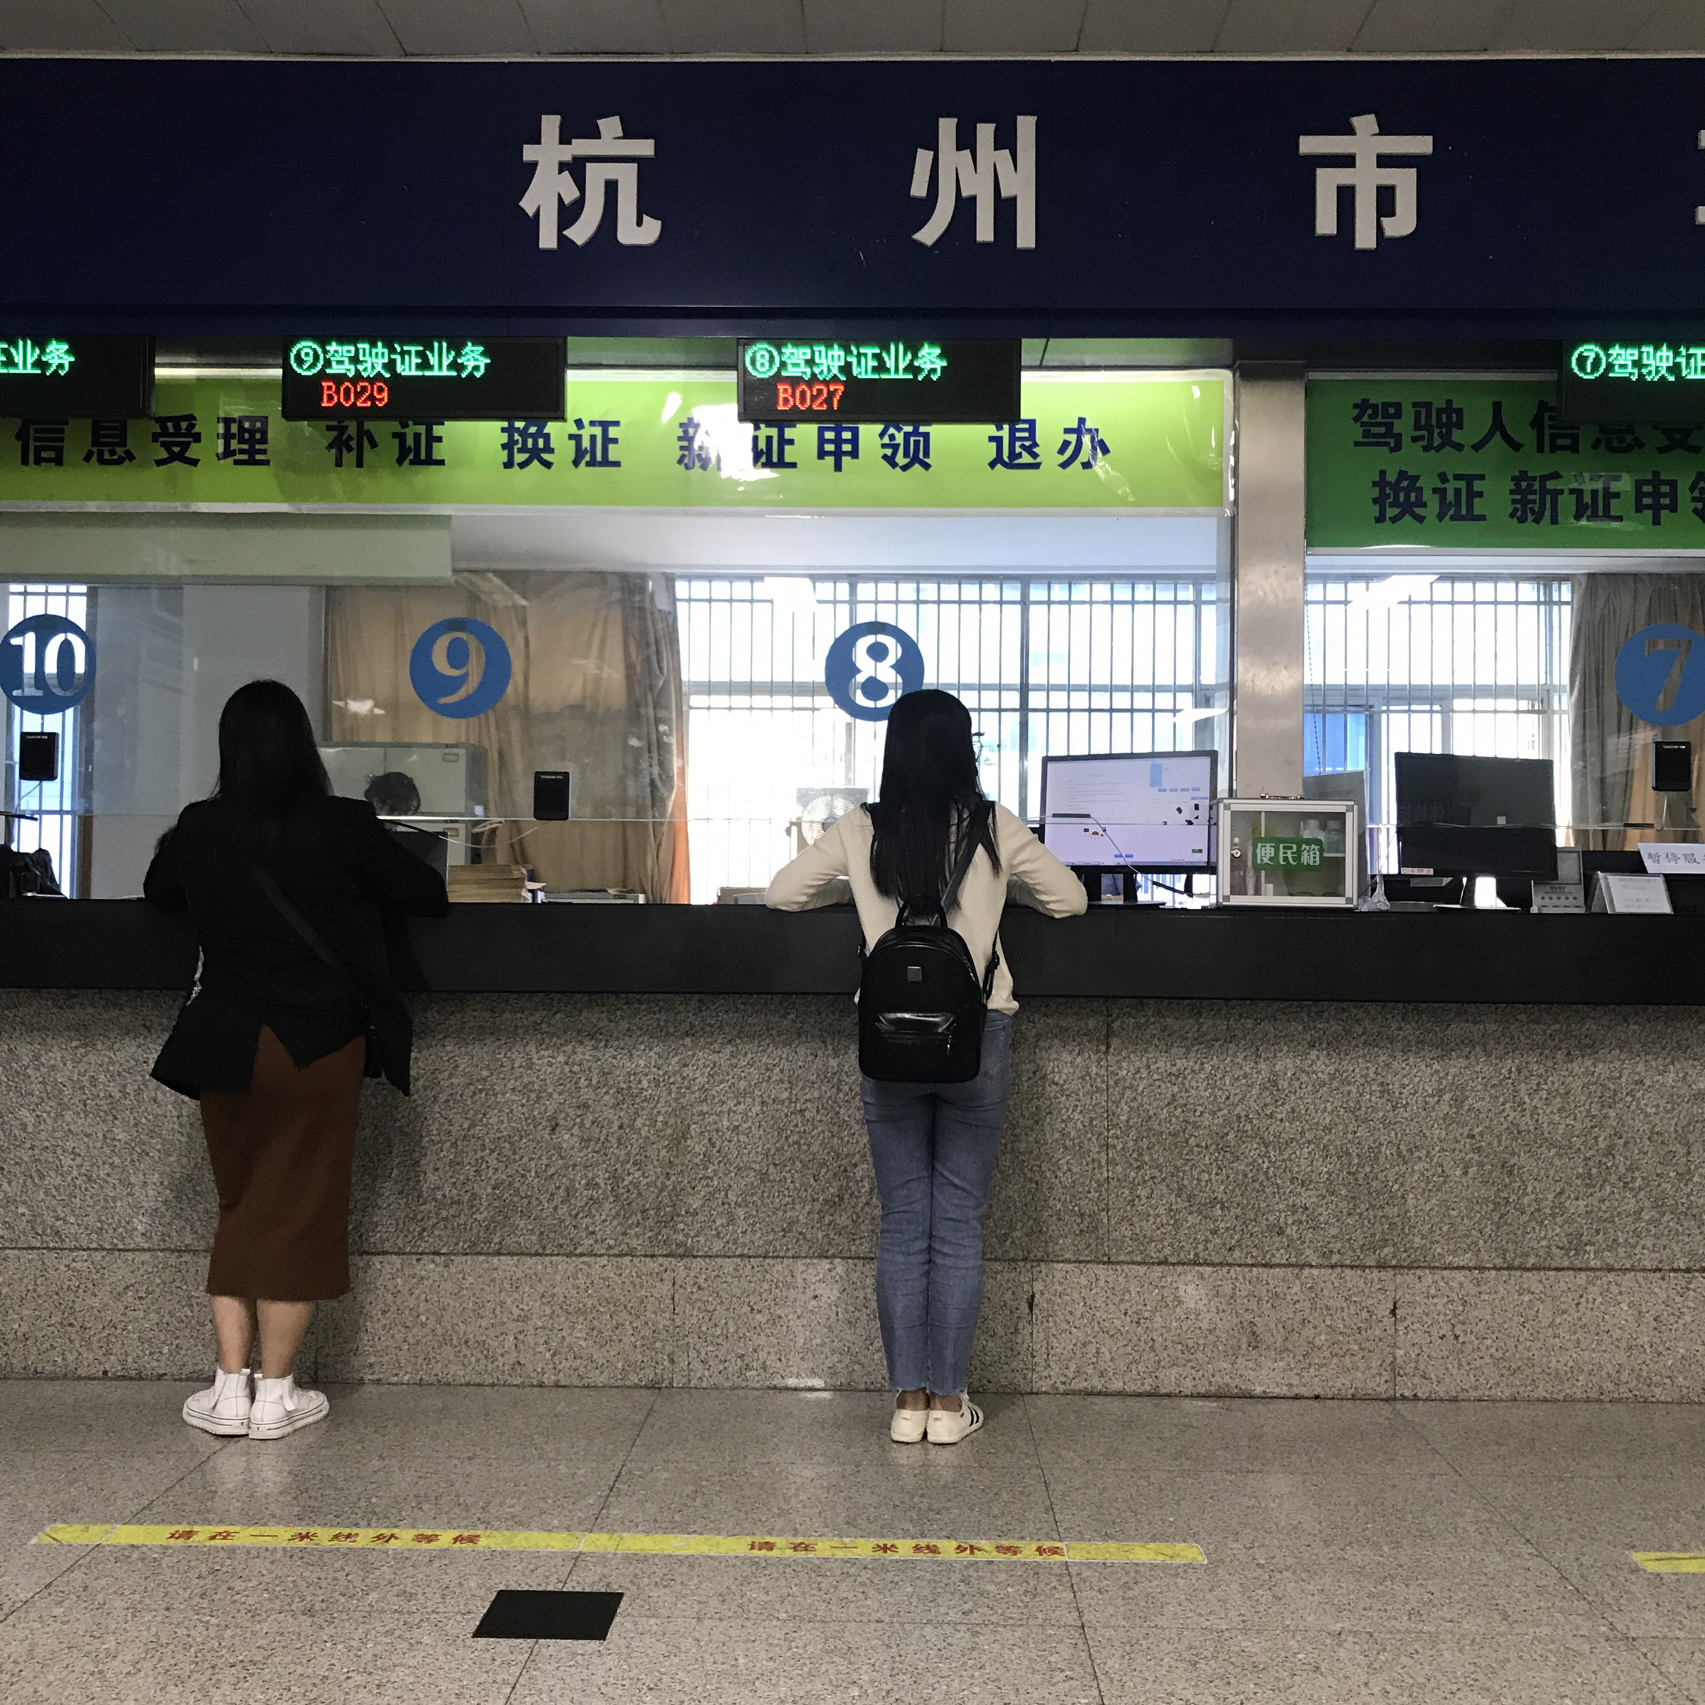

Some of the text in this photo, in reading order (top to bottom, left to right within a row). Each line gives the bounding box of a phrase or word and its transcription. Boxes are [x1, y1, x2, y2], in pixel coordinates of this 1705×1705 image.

[0, 338, 75, 376] 业务
[320, 381, 389, 408] B029
[776, 383, 846, 411] B027
[14, 414, 271, 469] 信息受理
[325, 421, 446, 470] 补证
[500, 419, 622, 470] 换证
[988, 417, 1111, 472] 退办
[1371, 469, 1487, 526] 换证
[8, 631, 88, 698] 10
[431, 631, 487, 705] 9
[848, 633, 905, 710] 8
[1644, 638, 1693, 712] 7
[1255, 842, 1321, 866] 便民箱
[1647, 851, 1705, 865] 暂停服
[165, 1528, 483, 1546] 请在一米线外等候
[748, 1539, 1067, 1558] 请在一米线外等候
